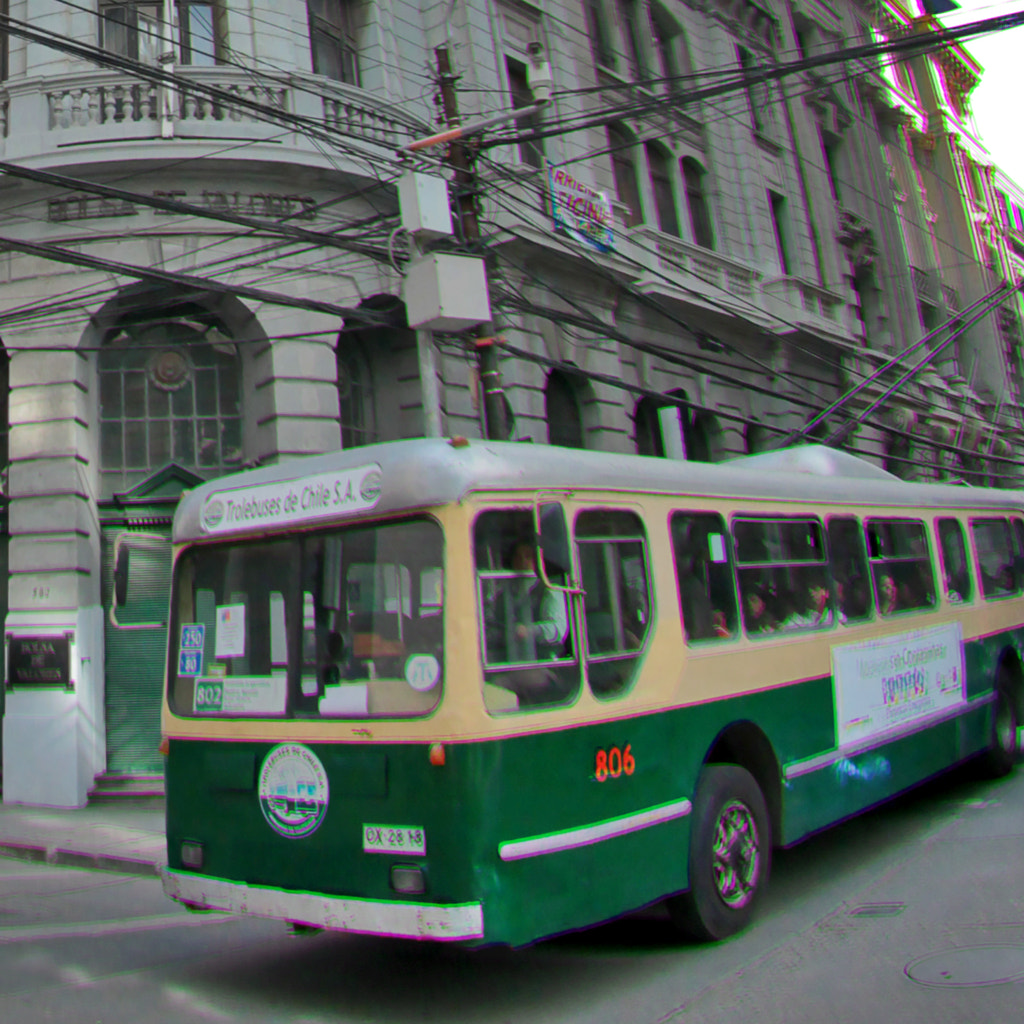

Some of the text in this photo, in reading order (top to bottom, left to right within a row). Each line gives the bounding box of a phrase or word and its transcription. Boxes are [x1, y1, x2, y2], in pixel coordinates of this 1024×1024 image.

[226, 477, 356, 522] Trolebuses de Chile S.A.
[21, 641, 55, 655] BOLSA
[197, 685, 222, 705] 802
[595, 744, 636, 783] 806
